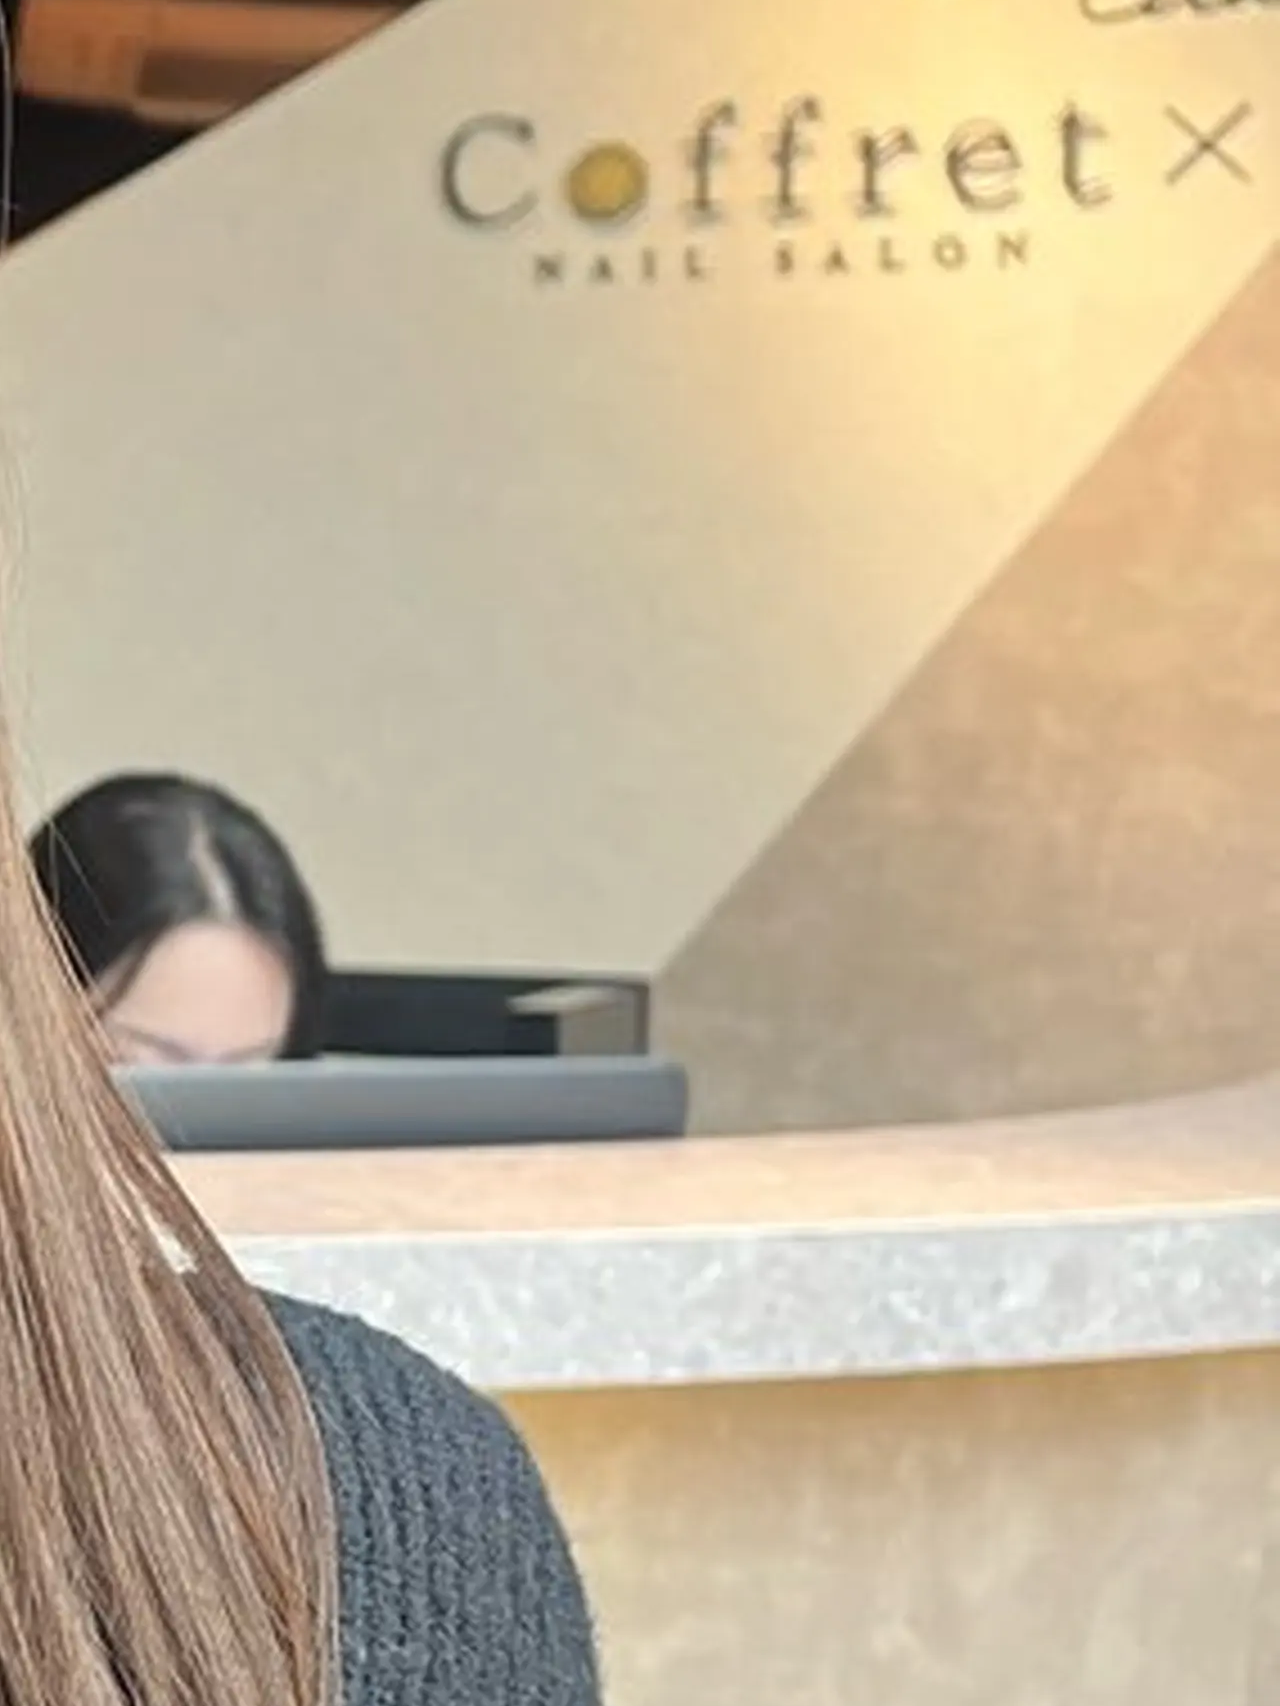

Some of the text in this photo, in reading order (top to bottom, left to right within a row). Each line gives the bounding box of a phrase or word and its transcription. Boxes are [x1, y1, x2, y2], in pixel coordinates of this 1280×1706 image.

[439, 95, 1114, 228] Coffret
[534, 233, 1029, 285] NAIL SALON
